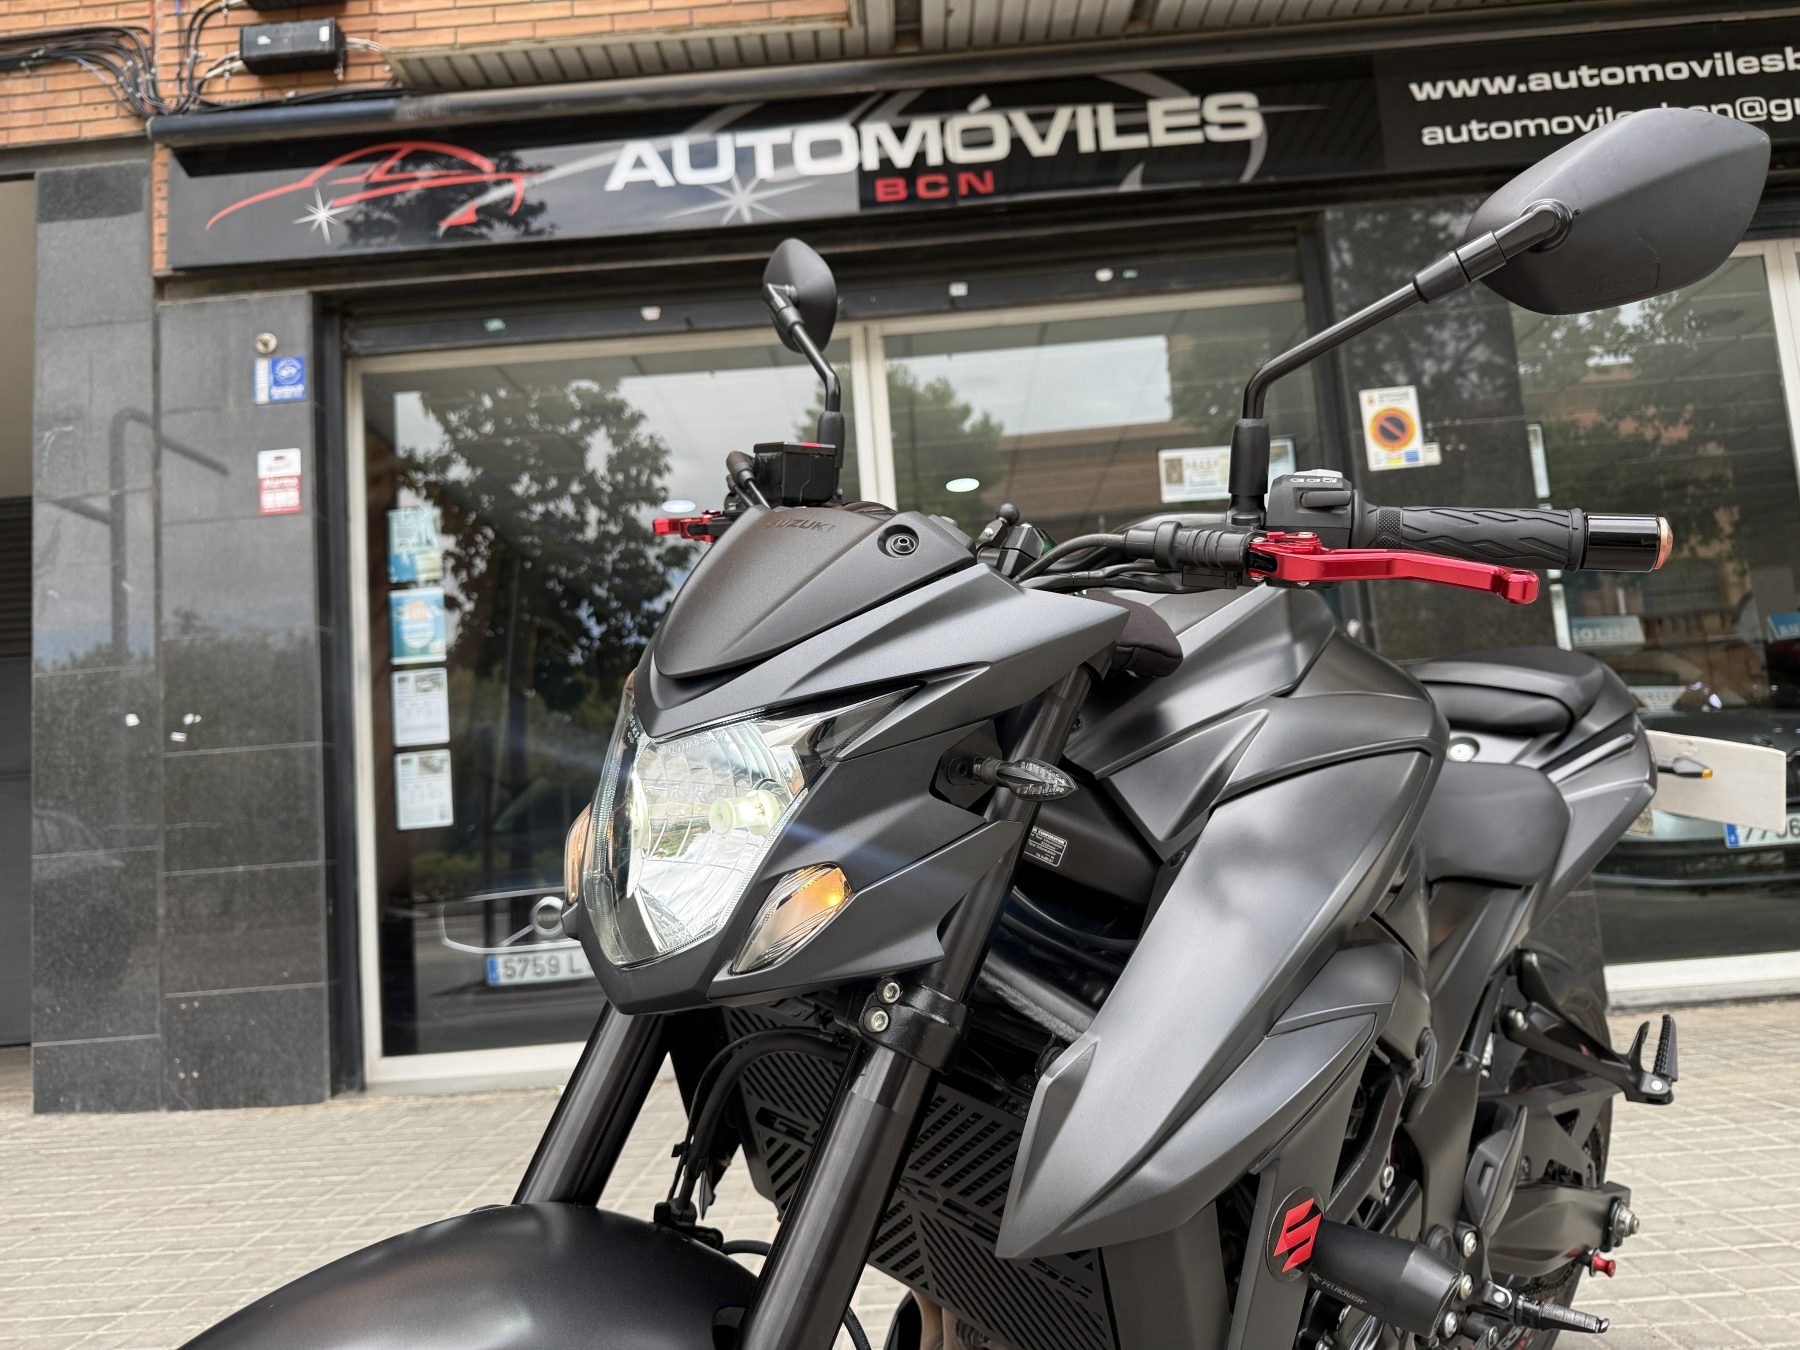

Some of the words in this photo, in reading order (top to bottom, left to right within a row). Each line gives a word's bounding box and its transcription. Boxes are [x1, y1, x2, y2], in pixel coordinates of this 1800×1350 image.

[603, 91, 1264, 192] AUTOMÓVILES
[875, 169, 995, 203] BCN
[764, 518, 836, 534] SUZUKI
[503, 954, 560, 980] 5759
